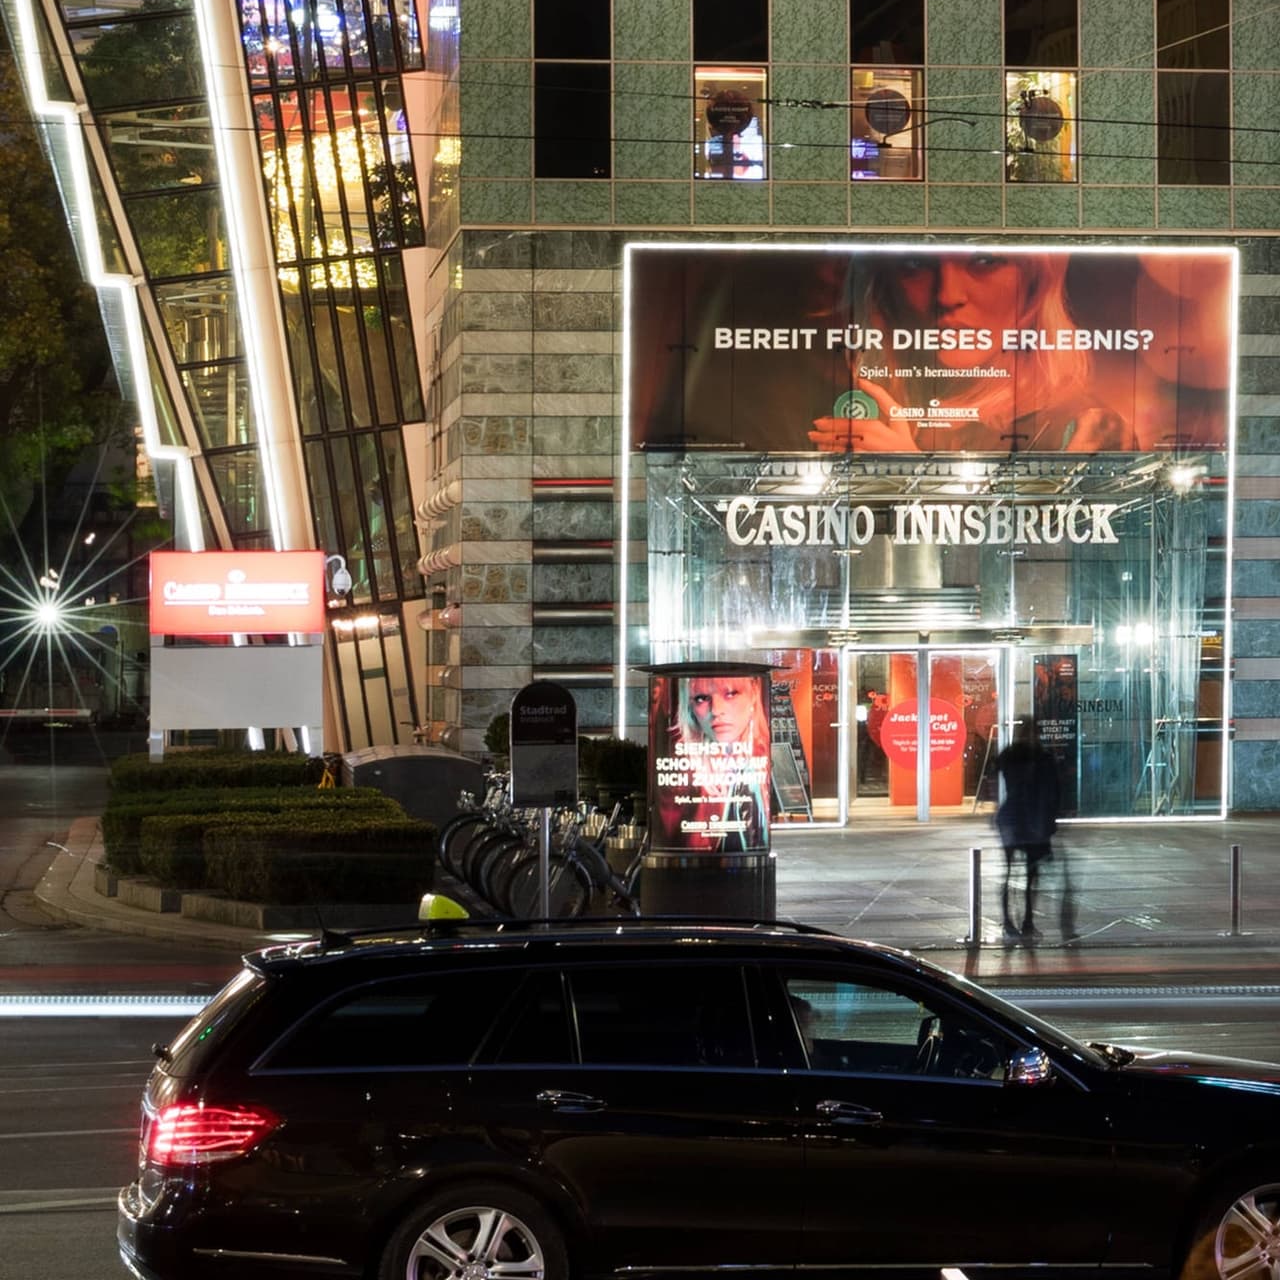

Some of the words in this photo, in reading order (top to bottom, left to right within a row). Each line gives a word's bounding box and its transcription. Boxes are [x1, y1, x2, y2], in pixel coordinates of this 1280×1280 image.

[714, 327, 817, 349] BEREIT
[827, 324, 883, 350] FÜR
[893, 328, 992, 350] DIESES
[1002, 329, 1154, 351] ERLEBNIS?
[860, 366, 892, 379] Spiel,
[924, 366, 1011, 378] herauszufinden.
[725, 495, 875, 546] CASINO
[893, 503, 1119, 545] INNSBRUCK
[675, 742, 728, 755] SIEHST
[733, 742, 752, 755] DU
[658, 773, 688, 786] DICH
